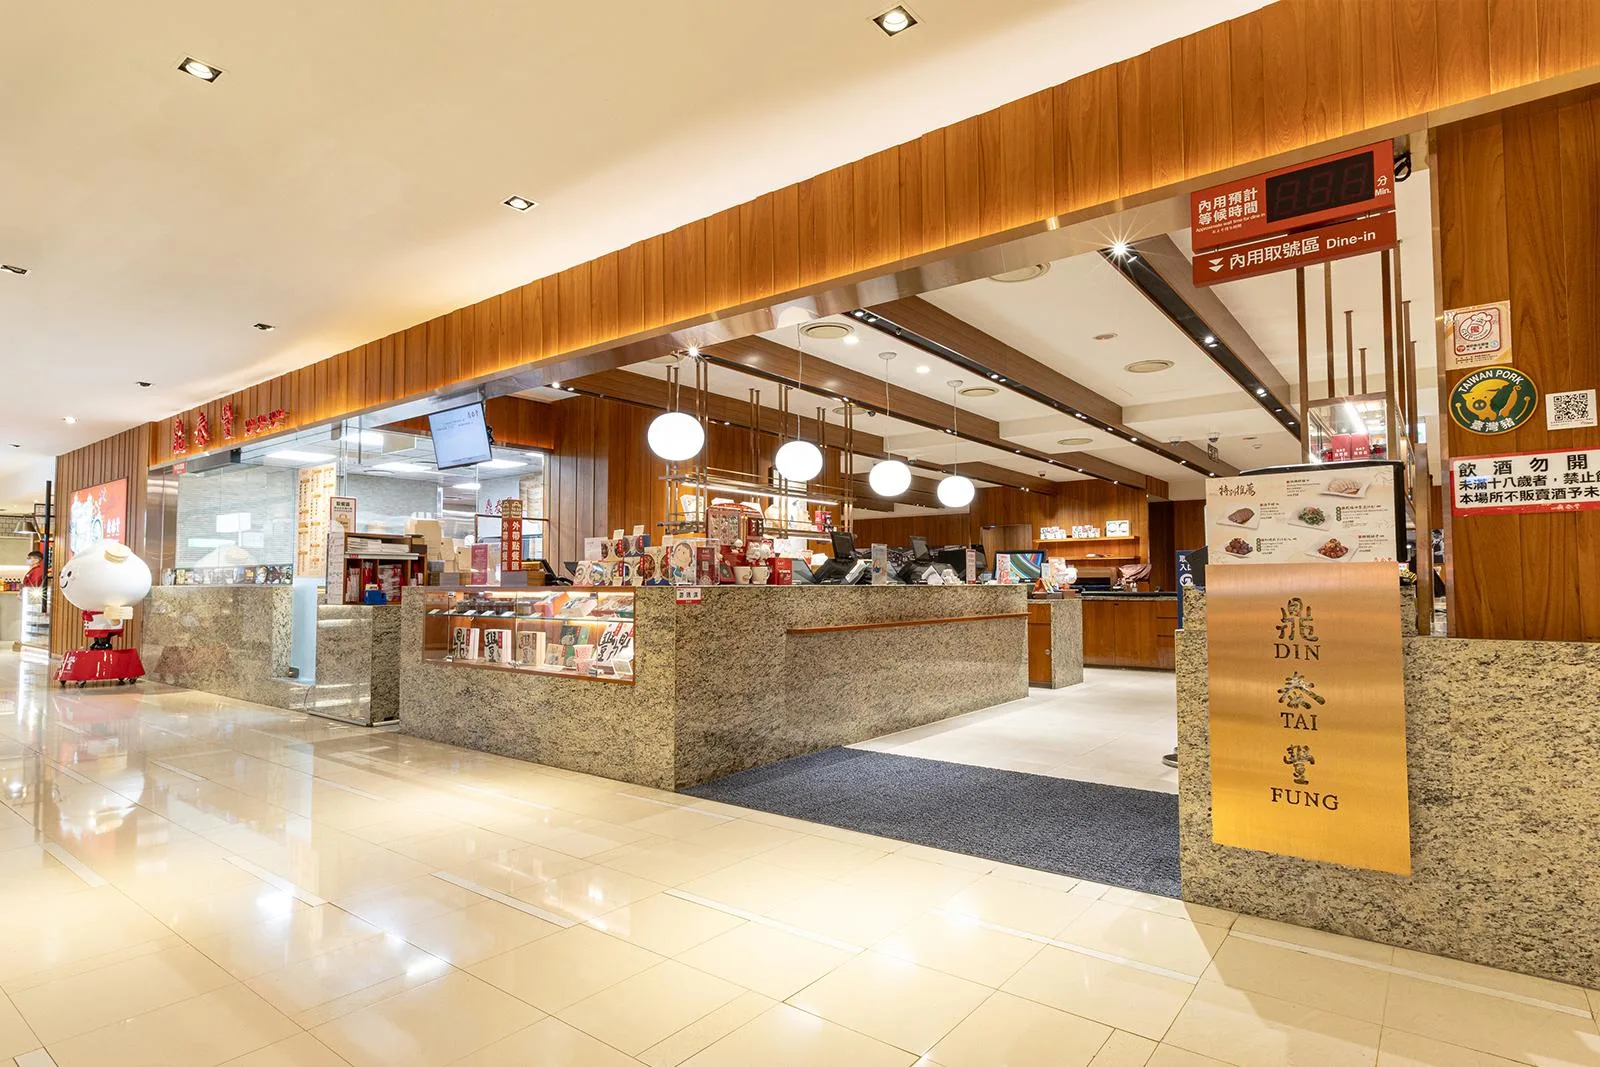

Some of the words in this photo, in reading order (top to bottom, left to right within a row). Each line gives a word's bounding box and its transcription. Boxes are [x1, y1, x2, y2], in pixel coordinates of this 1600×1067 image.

[1374, 187, 1392, 198] Min.
[1376, 175, 1388, 187] 分
[1198, 187, 1258, 214] 內用預計
[1198, 200, 1258, 226] 等候時間
[1229, 236, 1320, 271] 內用取號區
[1326, 231, 1376, 250] Dine-in
[1458, 370, 1493, 393] TAIWAN
[1495, 369, 1524, 385] PORK
[1459, 453, 1588, 478] 飲酒勿開
[1459, 485, 1600, 505] 本場所不販賣酒予未
[511, 521, 521, 571] 外帶點餐區
[1276, 597, 1319, 642] 鼎
[1274, 643, 1321, 661] DIN
[1277, 671, 1326, 710] 泰
[1280, 711, 1319, 731] TAI
[1271, 787, 1340, 811] FUNG
